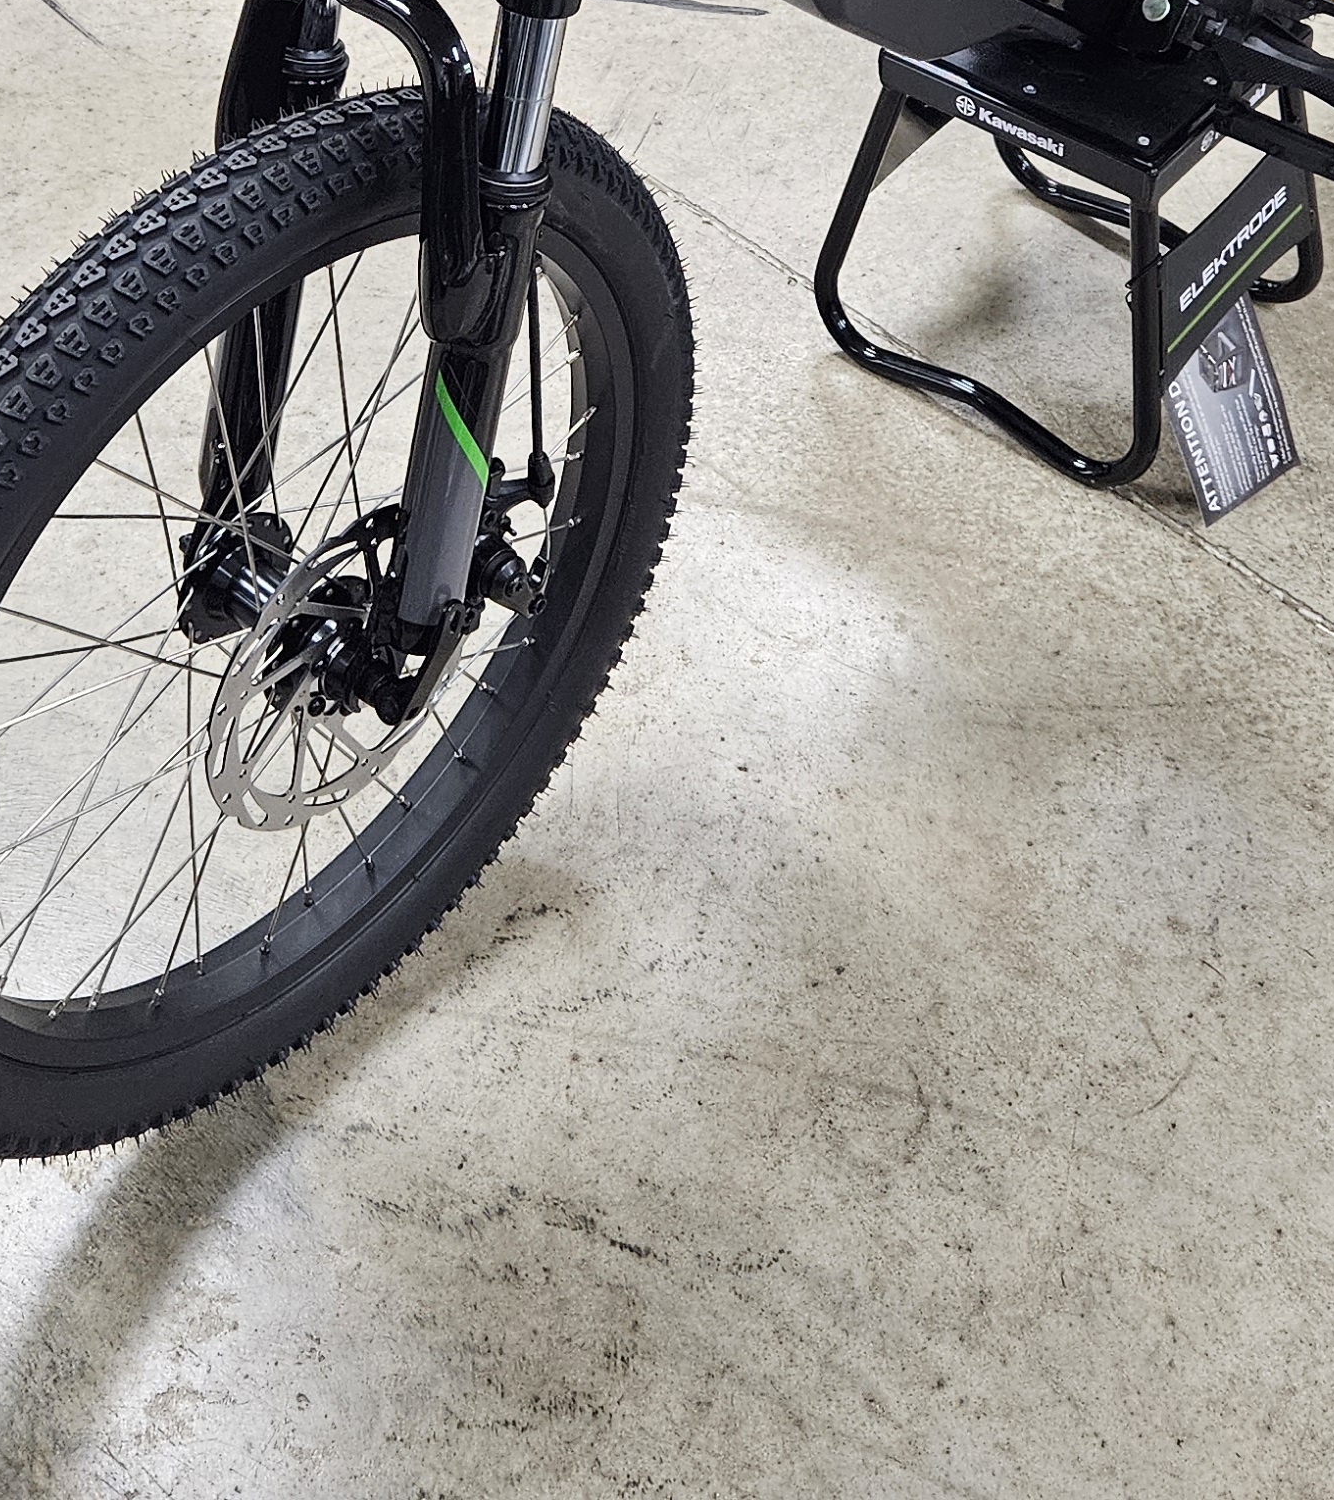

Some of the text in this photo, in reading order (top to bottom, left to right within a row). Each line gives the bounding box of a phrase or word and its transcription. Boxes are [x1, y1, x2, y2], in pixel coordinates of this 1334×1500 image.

[978, 106, 1065, 157] Kawasaki
[1179, 185, 1288, 313] ELEKTRODE
[1174, 401, 1222, 512] ATTENTION
